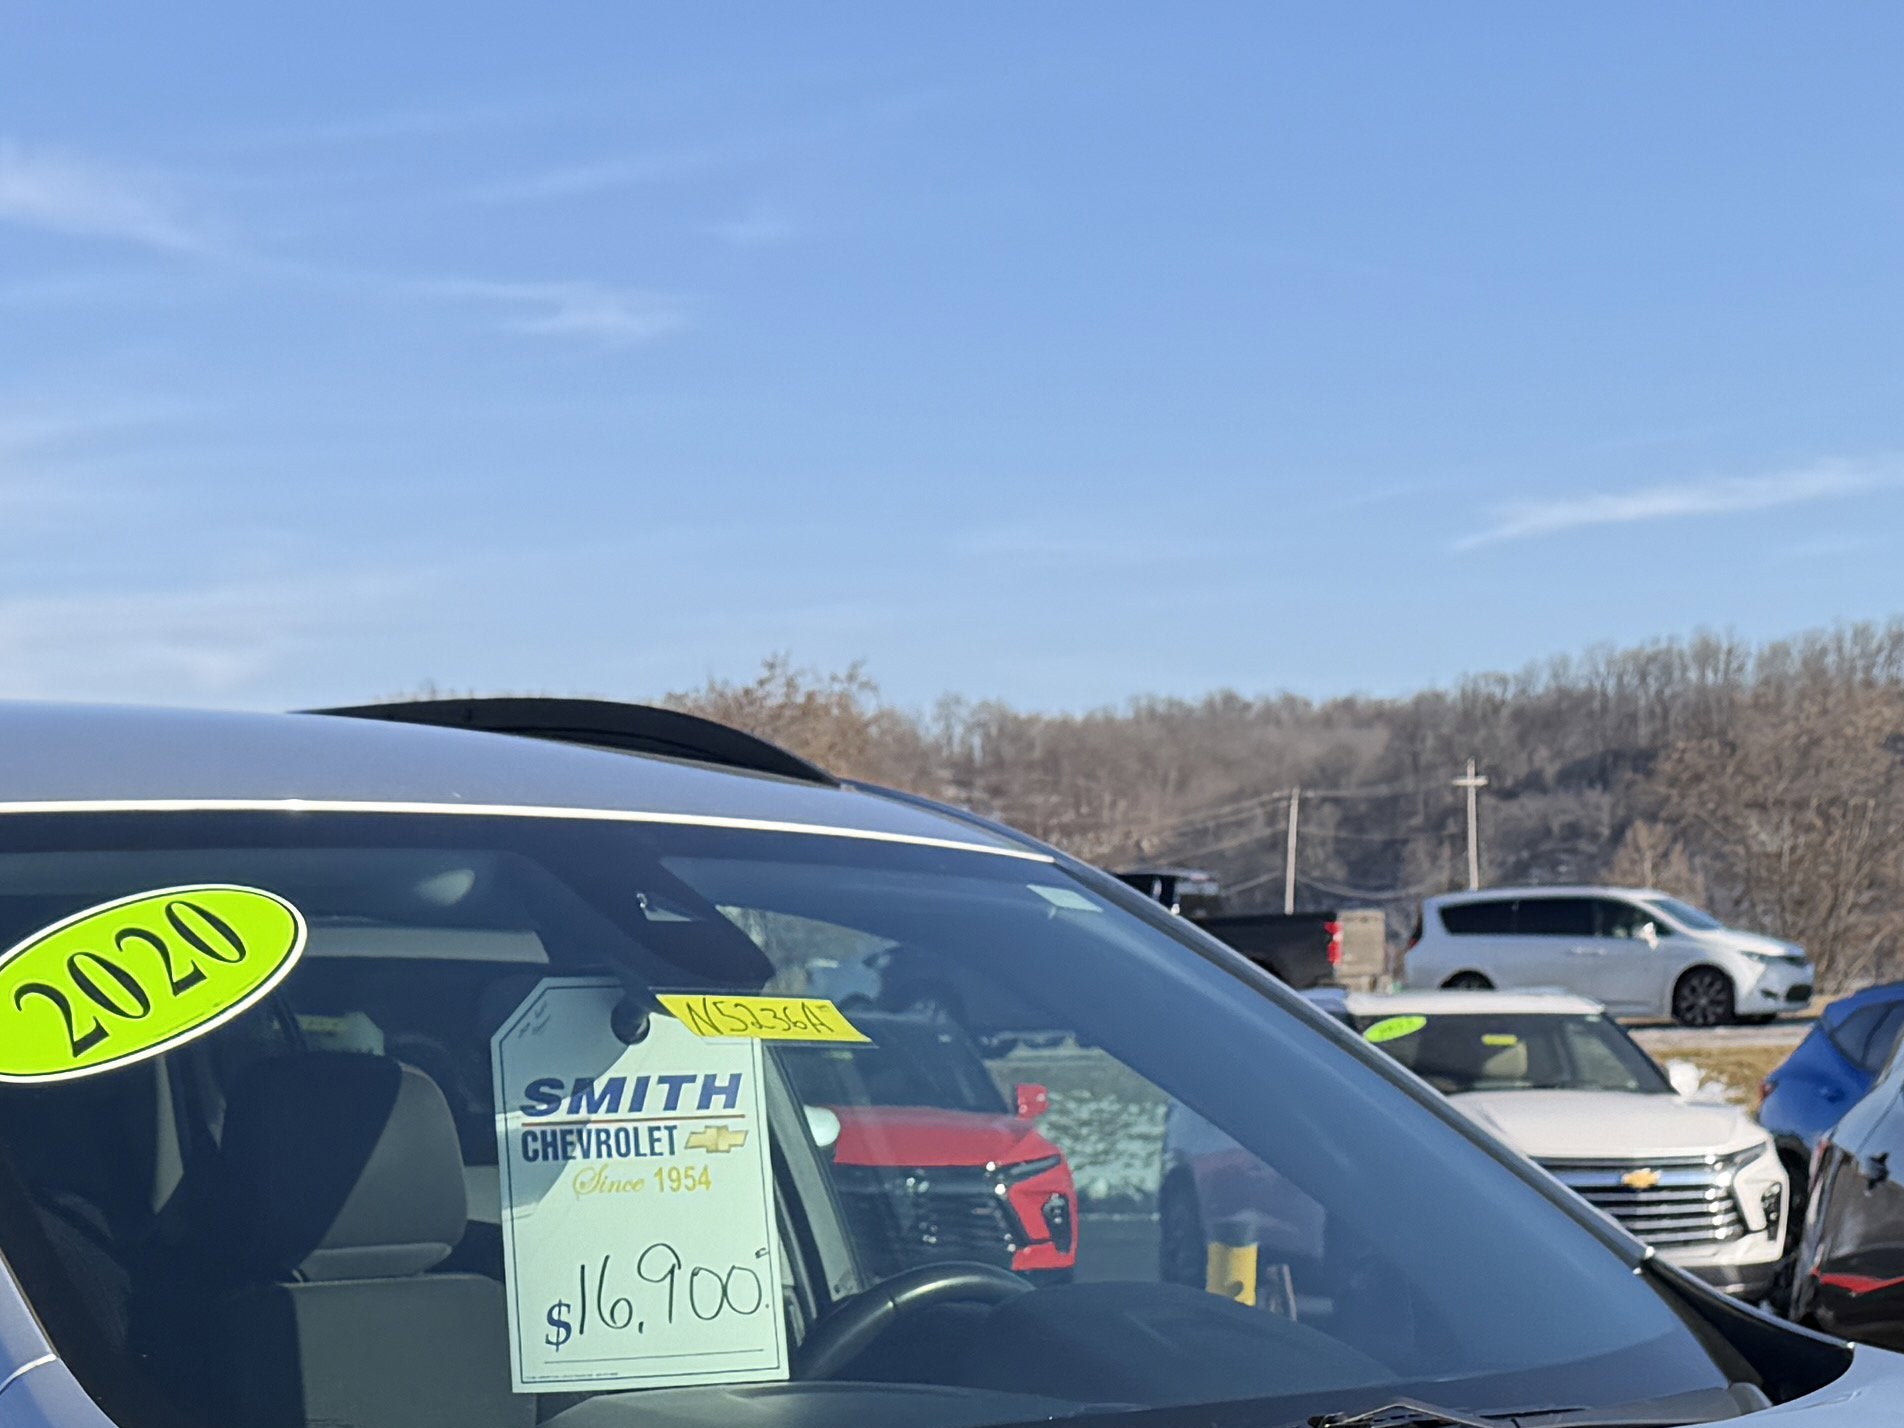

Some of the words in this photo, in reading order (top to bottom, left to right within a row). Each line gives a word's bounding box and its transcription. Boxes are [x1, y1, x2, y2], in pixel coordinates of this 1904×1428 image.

[14, 900, 247, 1059] 2020
[685, 998, 834, 1036] N5236A
[519, 1073, 744, 1117] SMITH
[521, 1125, 678, 1162] CHEVROLET
[573, 1163, 646, 1200] Since
[654, 1165, 713, 1193] 1954
